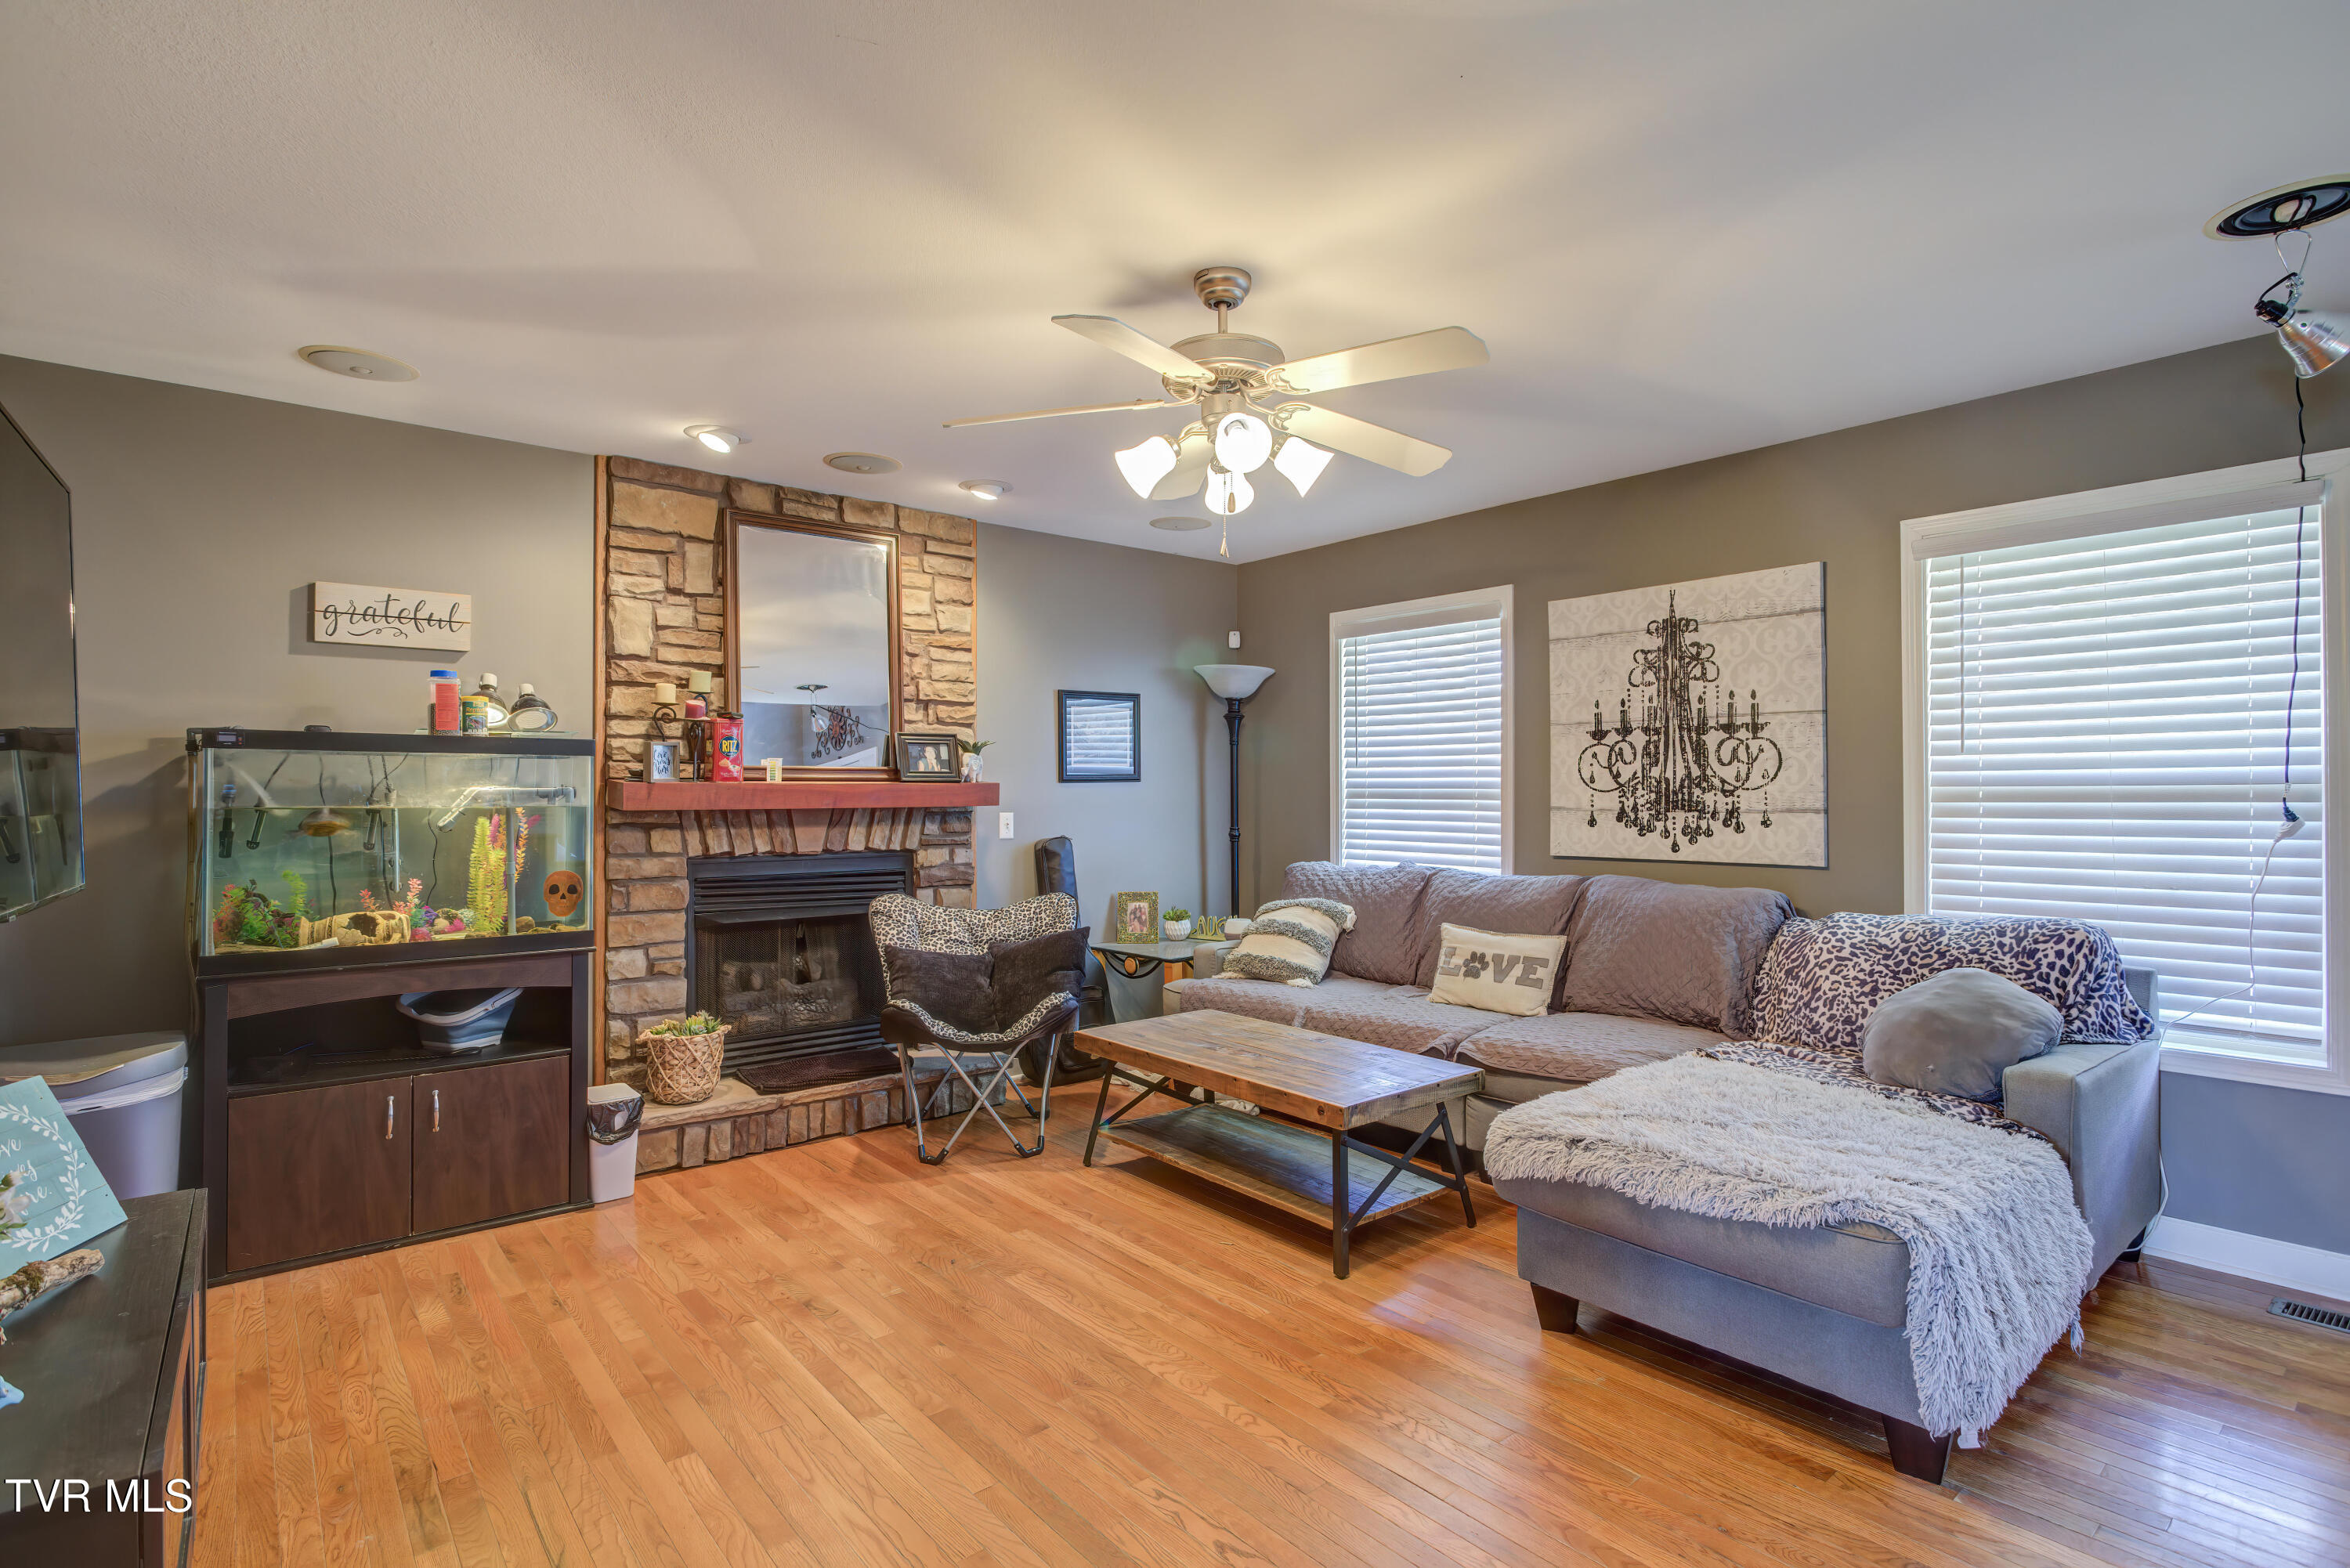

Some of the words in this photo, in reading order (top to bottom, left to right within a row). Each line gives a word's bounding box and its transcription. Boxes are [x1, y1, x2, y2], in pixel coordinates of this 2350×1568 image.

[323, 594, 464, 636] grateful
[721, 739, 738, 753] RITZ
[1190, 915, 1238, 936] AUG
[1439, 947, 1549, 990] LVE
